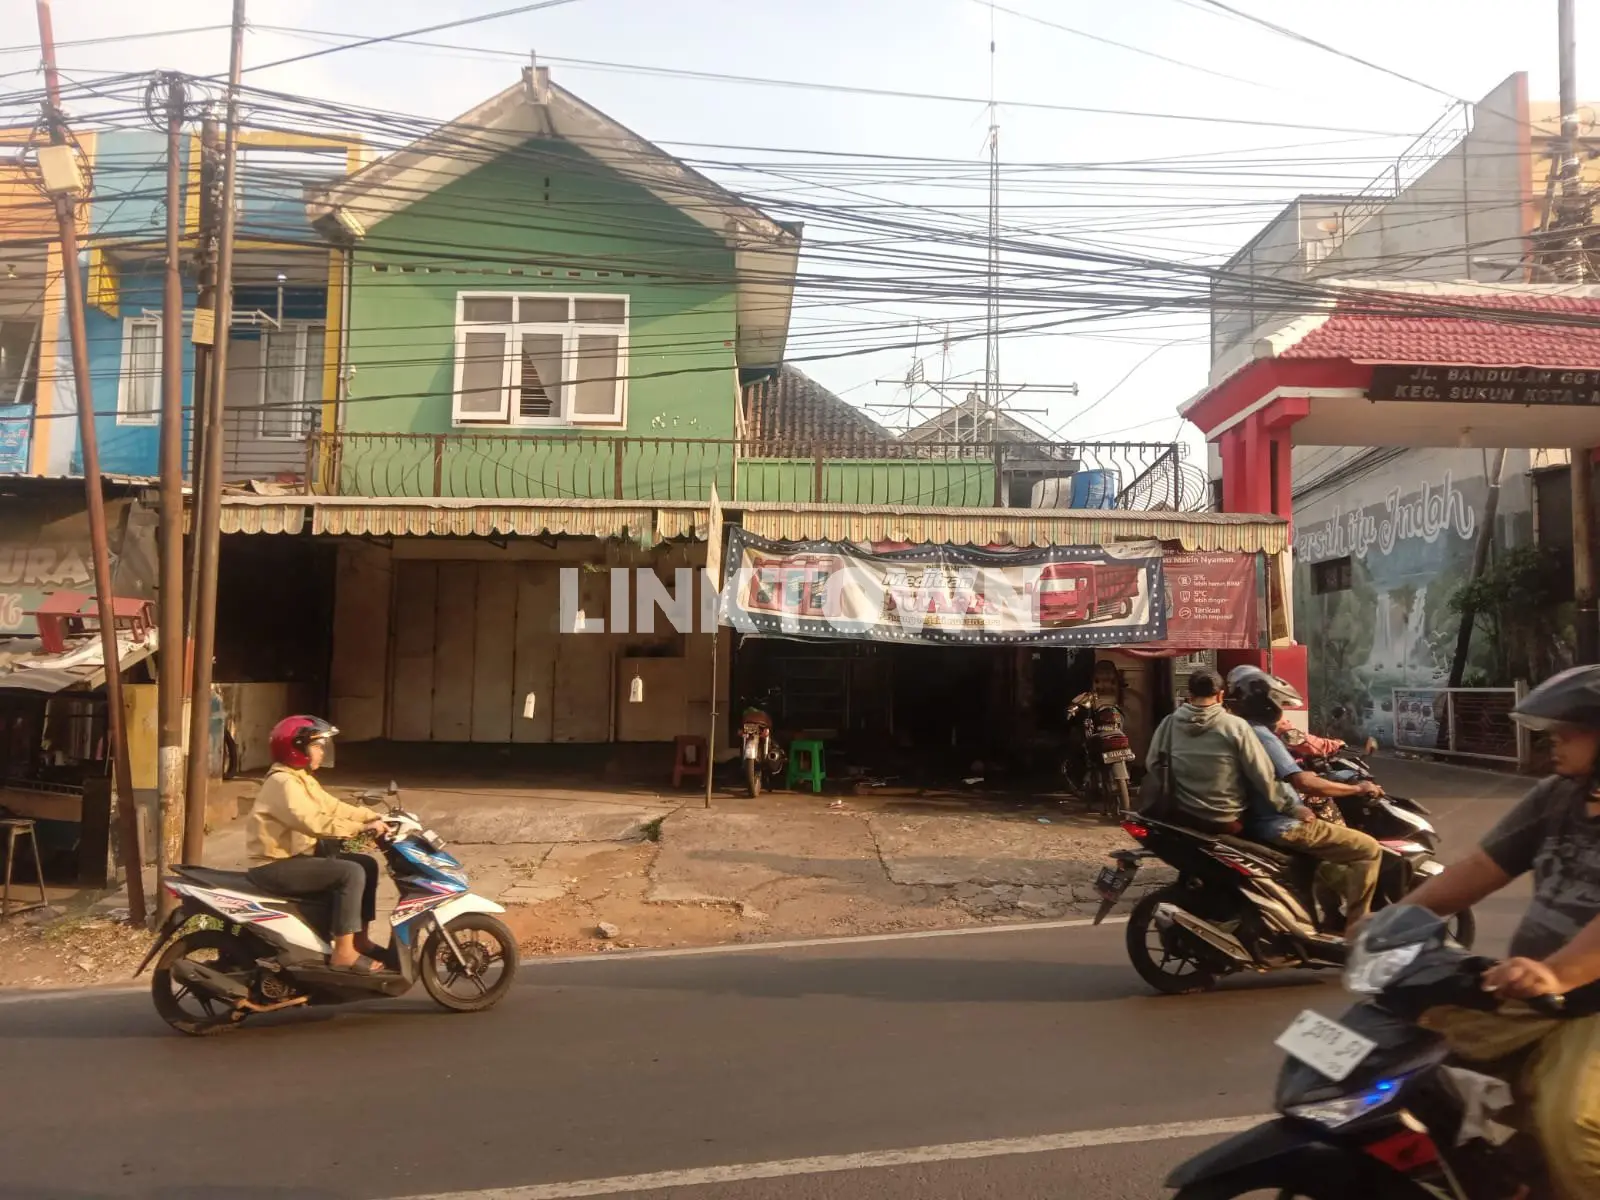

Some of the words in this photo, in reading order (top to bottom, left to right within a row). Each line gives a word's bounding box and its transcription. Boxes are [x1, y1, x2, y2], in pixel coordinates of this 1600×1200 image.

[1410, 367, 1437, 381] JL.
[1395, 385, 1441, 398] KEC.
[1449, 386, 1514, 400] SUKUN
[1523, 388, 1574, 402] KOTA
[1379, 468, 1475, 556] Indah
